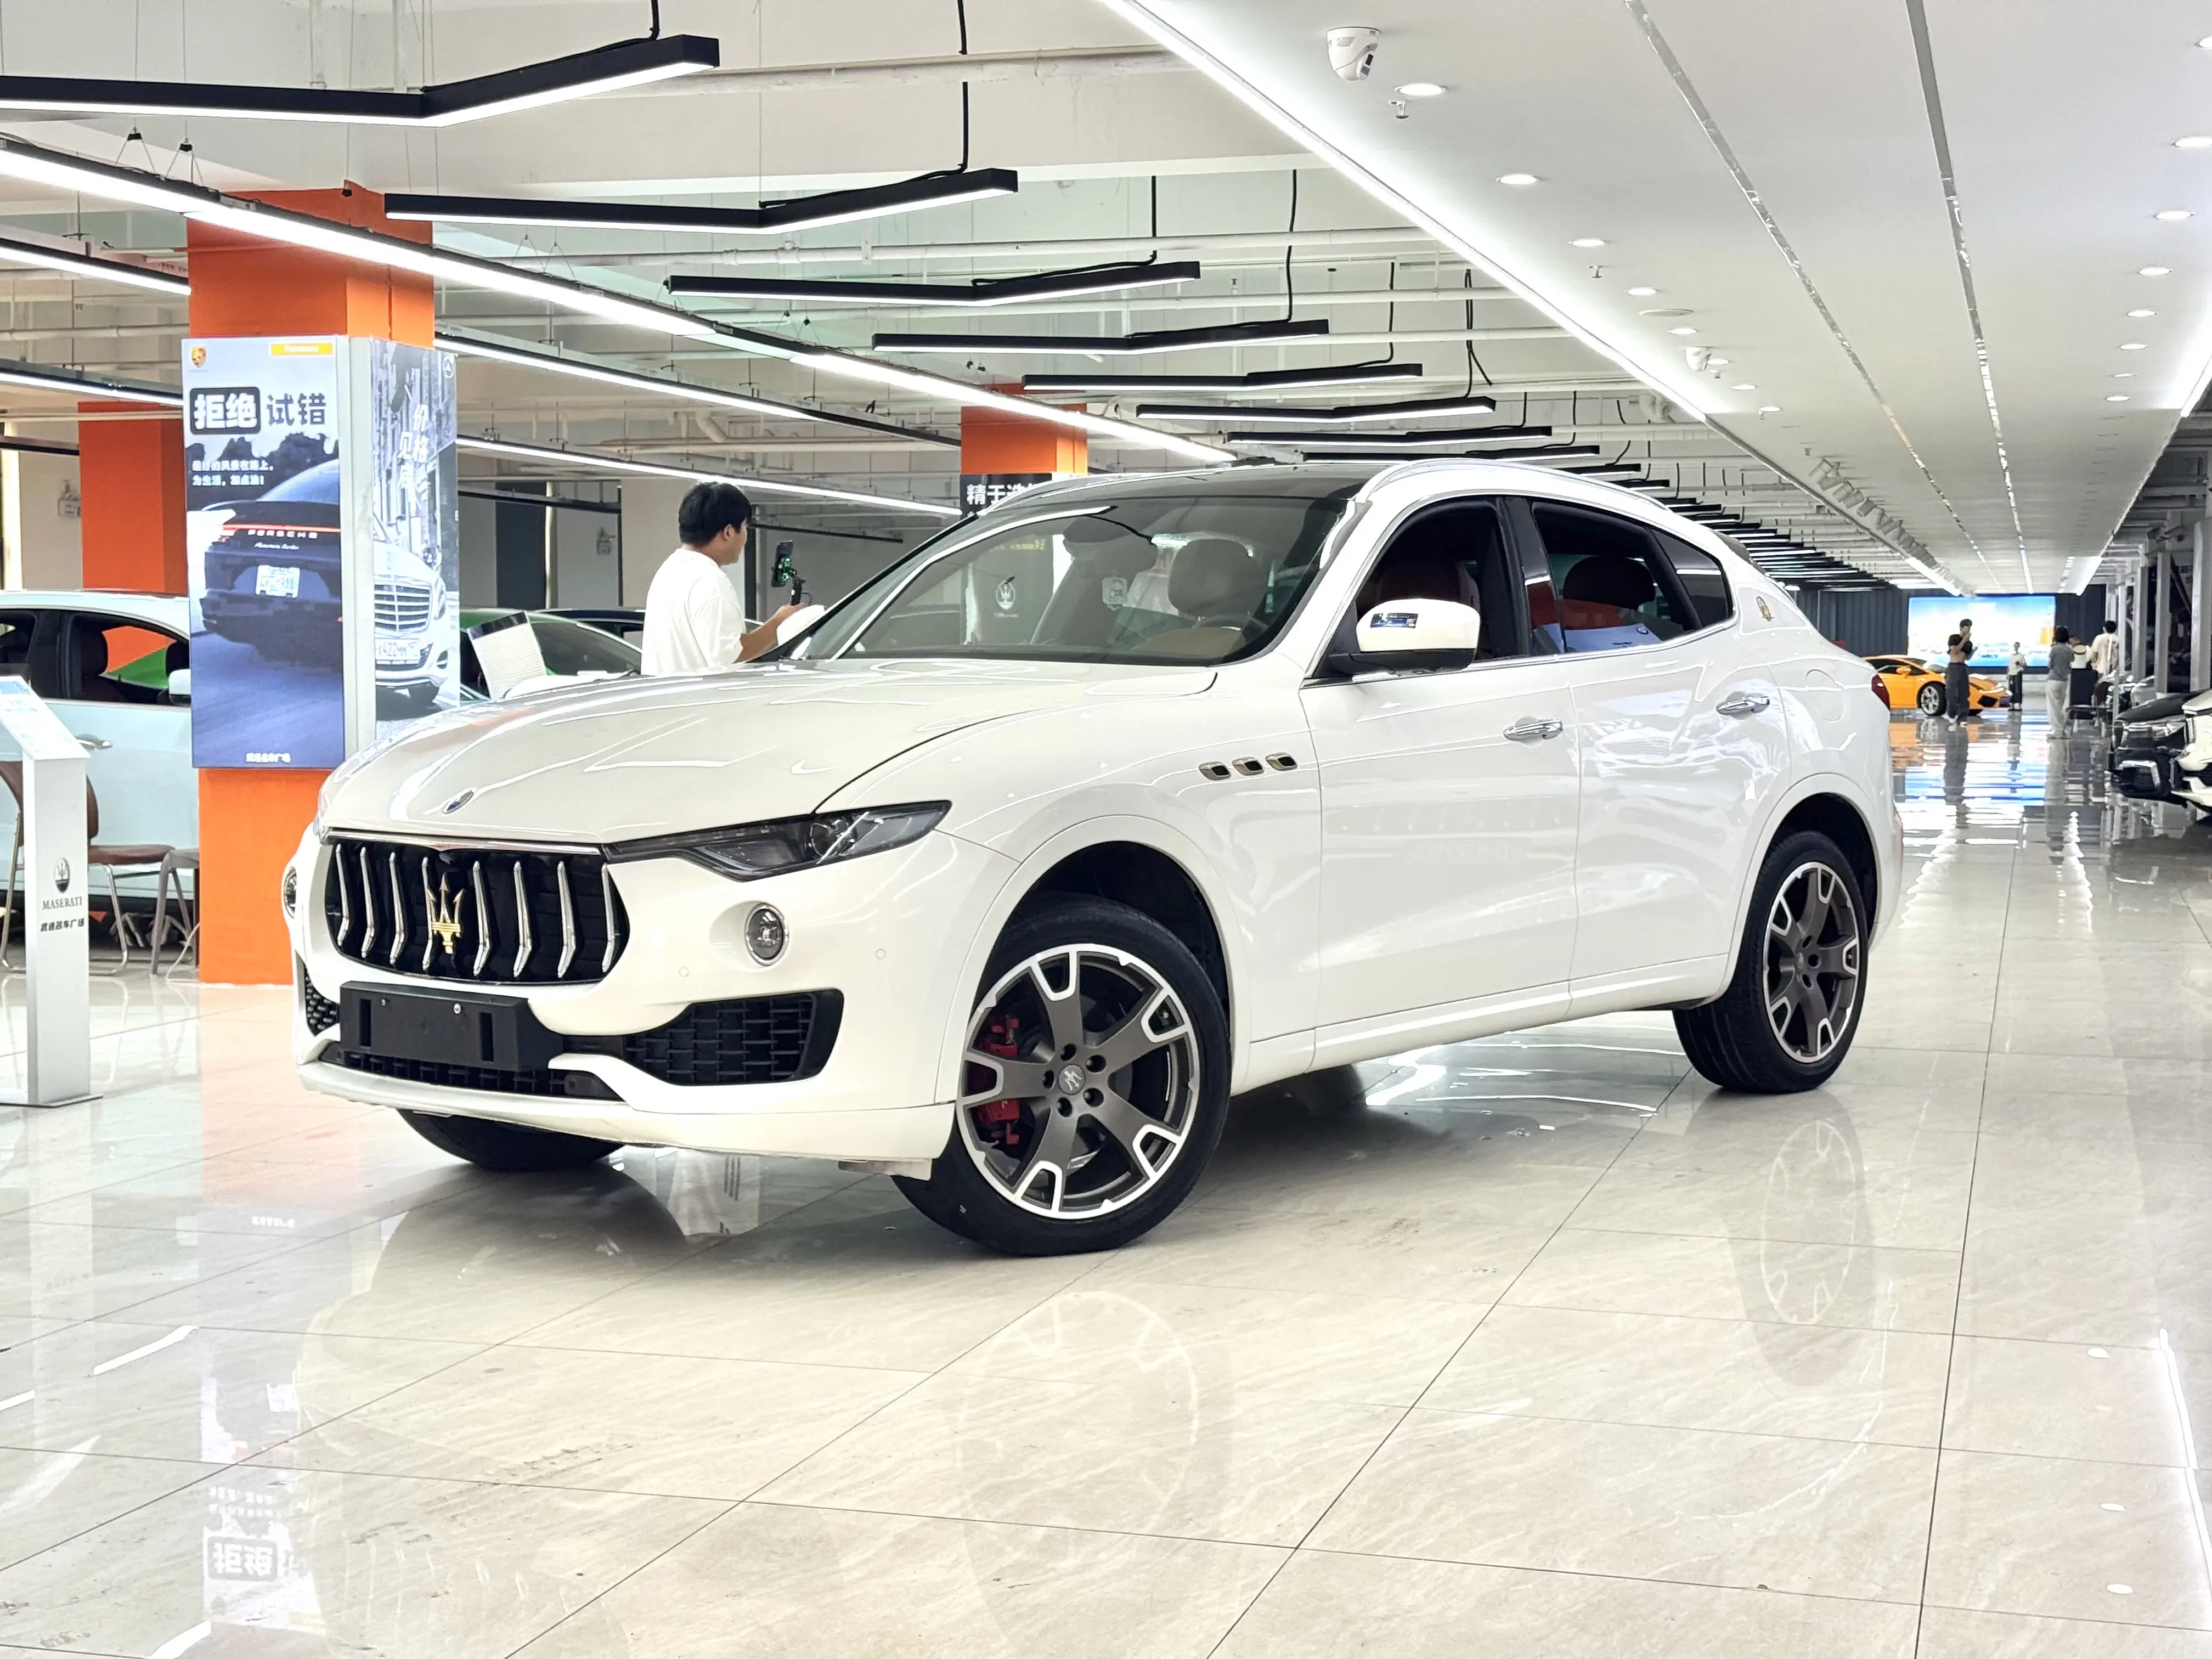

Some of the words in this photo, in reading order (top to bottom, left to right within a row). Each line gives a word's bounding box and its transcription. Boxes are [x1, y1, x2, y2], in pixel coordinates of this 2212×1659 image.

[194, 392, 258, 430] 拒绝
[266, 392, 326, 426] 试错
[42, 896, 82, 910] MASERATI
